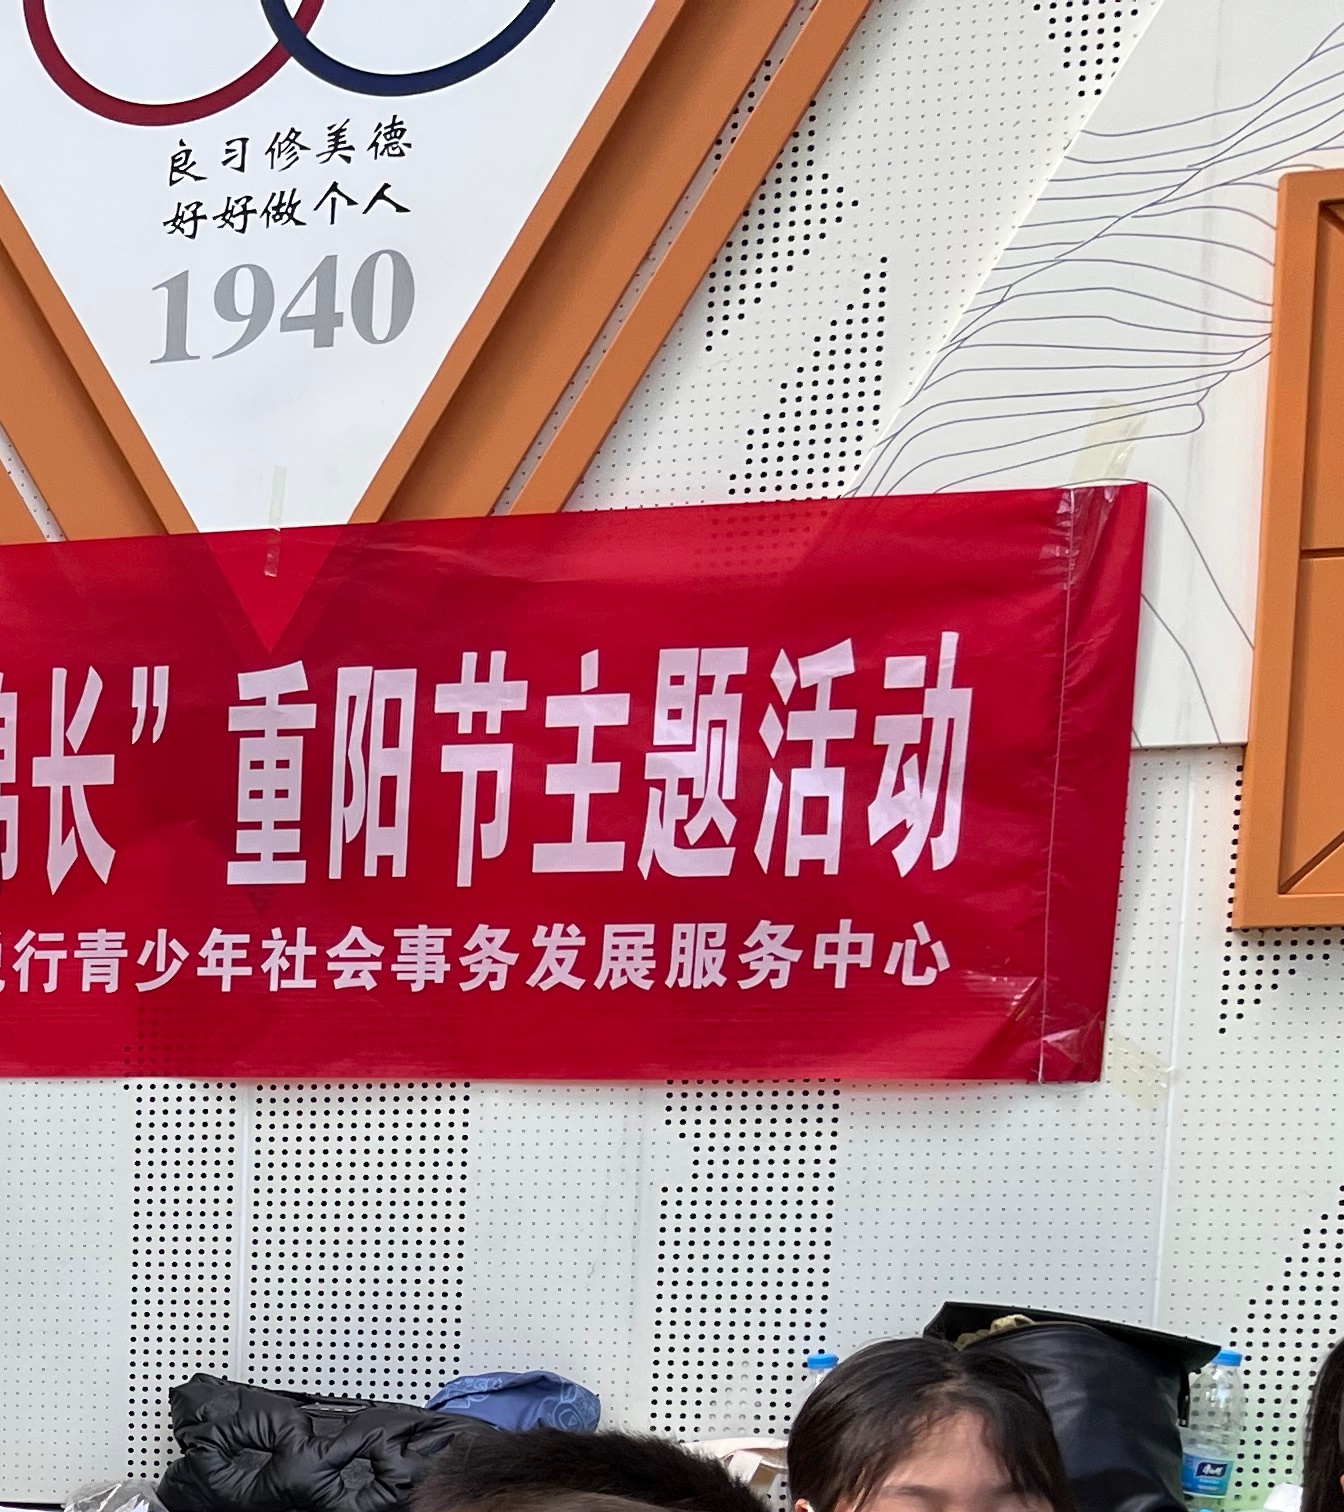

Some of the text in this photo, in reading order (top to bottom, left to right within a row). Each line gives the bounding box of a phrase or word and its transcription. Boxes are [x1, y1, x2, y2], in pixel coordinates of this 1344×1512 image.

[169, 114, 414, 187] 良习修美德
[162, 181, 412, 241] 好好做个人
[149, 248, 416, 365] 1940
